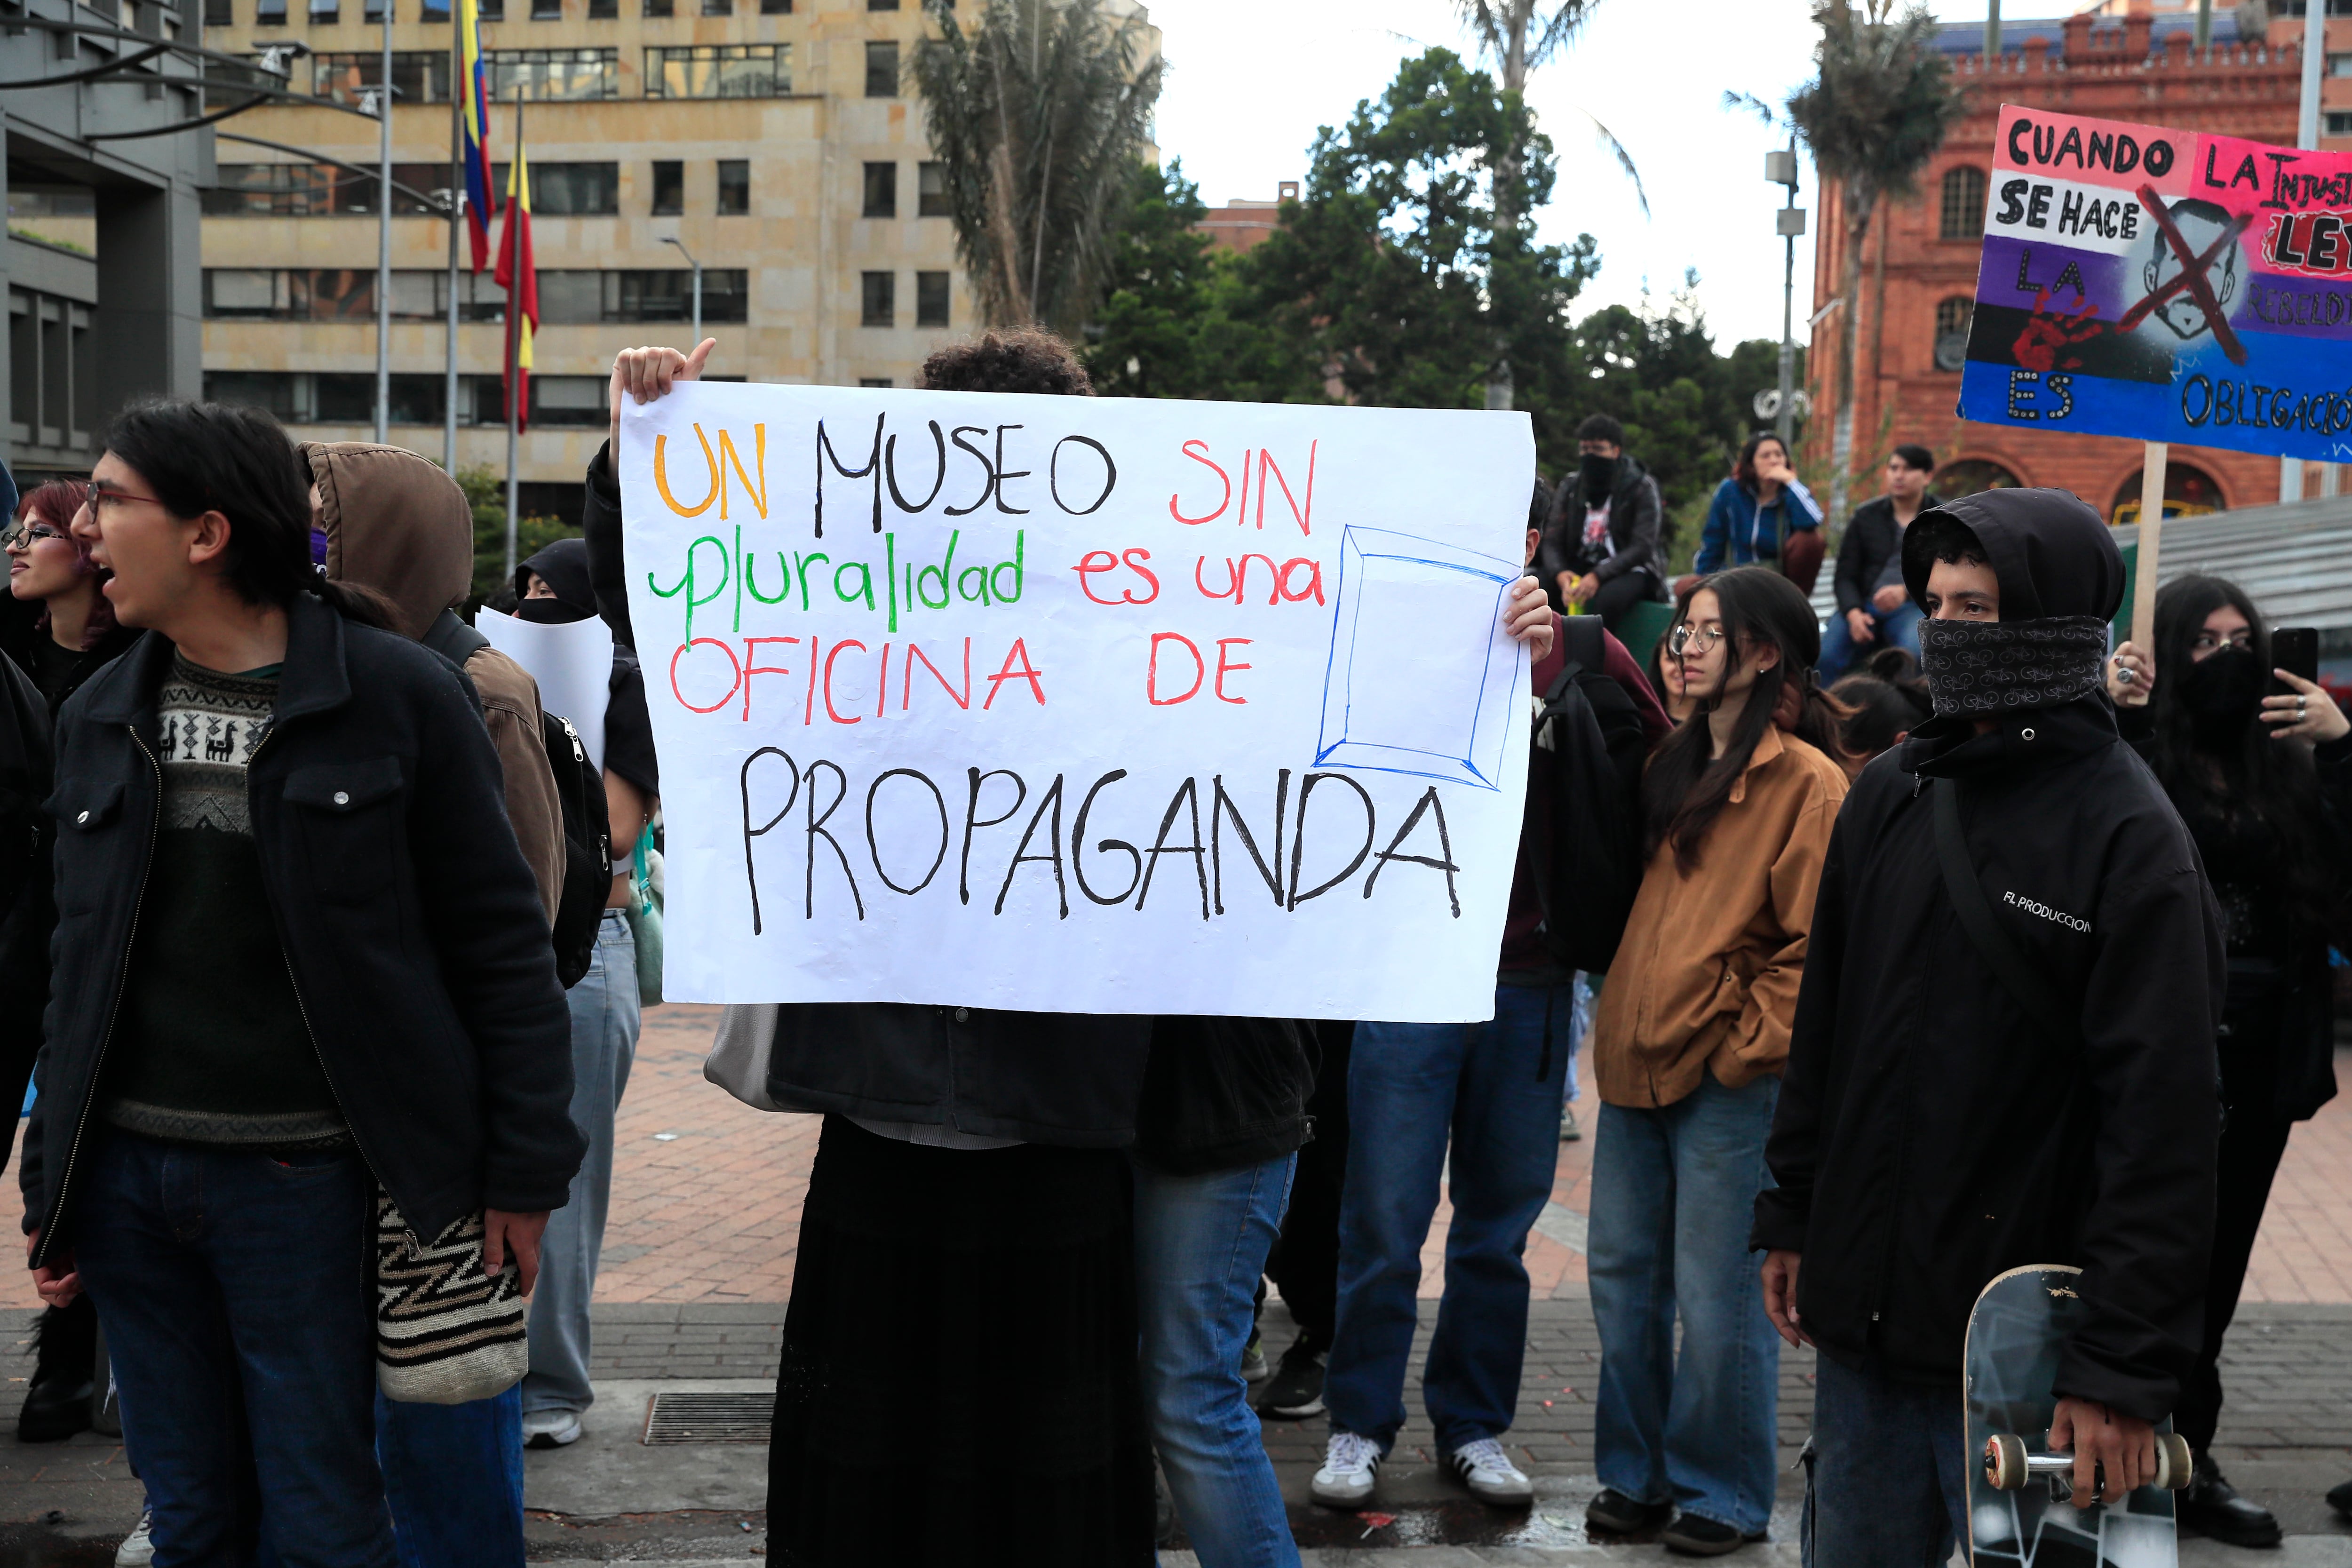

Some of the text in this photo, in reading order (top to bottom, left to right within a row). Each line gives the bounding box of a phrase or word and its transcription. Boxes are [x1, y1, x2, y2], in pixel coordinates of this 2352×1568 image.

[1996, 179, 2053, 229] SE
[2058, 190, 2139, 239] HACE
[2009, 119, 2352, 211] CUANDO LA INJUST
[2016, 248, 2085, 295] LA
[2008, 370, 2352, 436] ES OBLIGACIÓ
[655, 411, 1317, 539] UN MUSEO SIN
[648, 524, 1325, 652] pluralidad es una
[670, 632, 1254, 725] OFICINA DE
[741, 747, 1461, 936] PROPAGANDA
